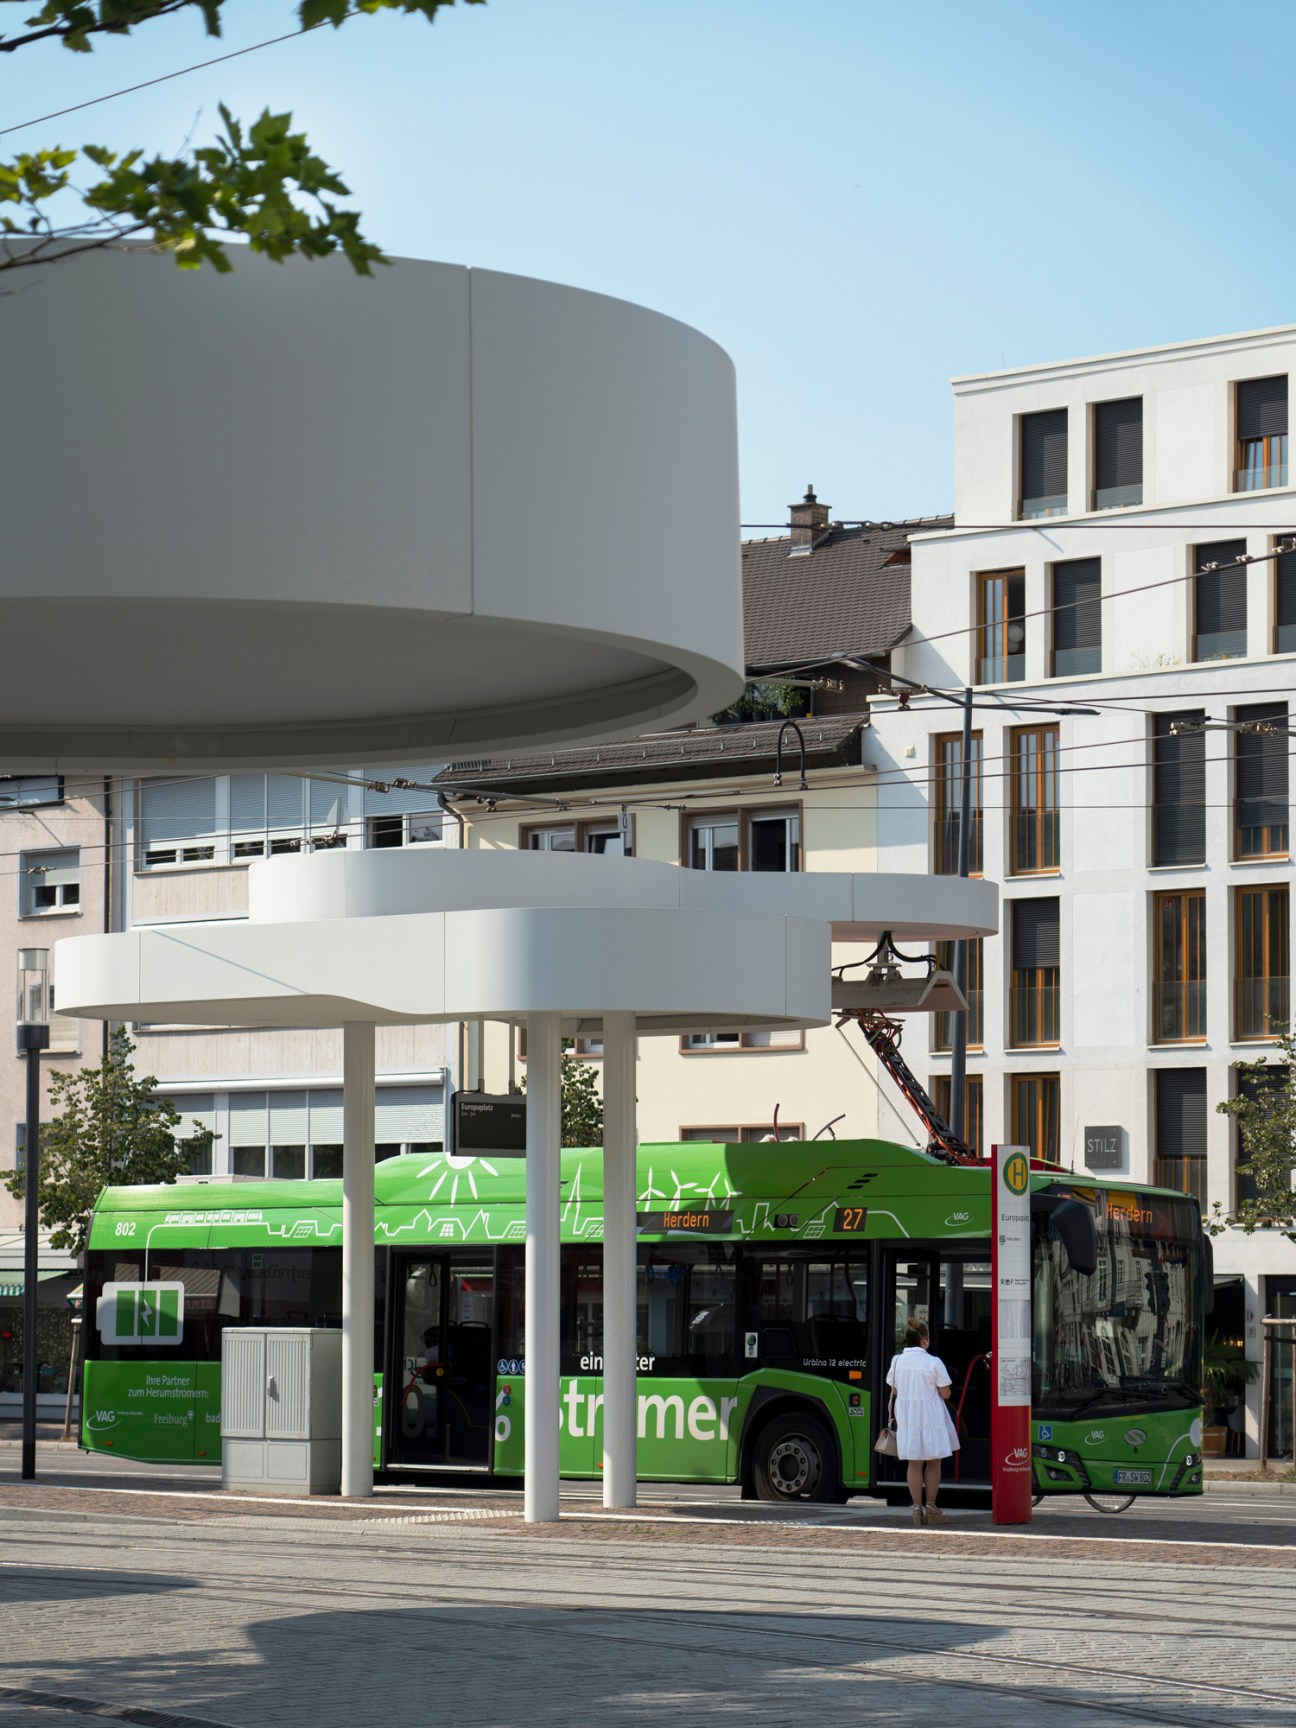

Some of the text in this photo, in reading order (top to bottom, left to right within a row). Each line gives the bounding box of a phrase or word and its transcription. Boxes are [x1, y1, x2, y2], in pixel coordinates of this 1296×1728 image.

[461, 1102, 494, 1112] Europaplatz
[1087, 1138, 1117, 1153] STILZ
[1013, 1162, 1025, 1187] H
[663, 1211, 710, 1228] Herdern
[843, 1209, 863, 1230] 27
[953, 1212, 970, 1221] VAG
[1105, 1201, 1153, 1224] Herdern
[115, 1221, 136, 1236] 802
[580, 1352, 603, 1370] ein
[802, 1358, 867, 1367] Urbino 12 electric
[146, 1375, 190, 1386] Ihre Partner
[128, 1388, 144, 1397] zum
[559, 1378, 738, 1441] trmer
[96, 1410, 115, 1422] VAG
[154, 1413, 187, 1427] Freiburg
[1091, 1430, 1104, 1439] VAG
[1013, 1447, 1027, 1458] VAG
